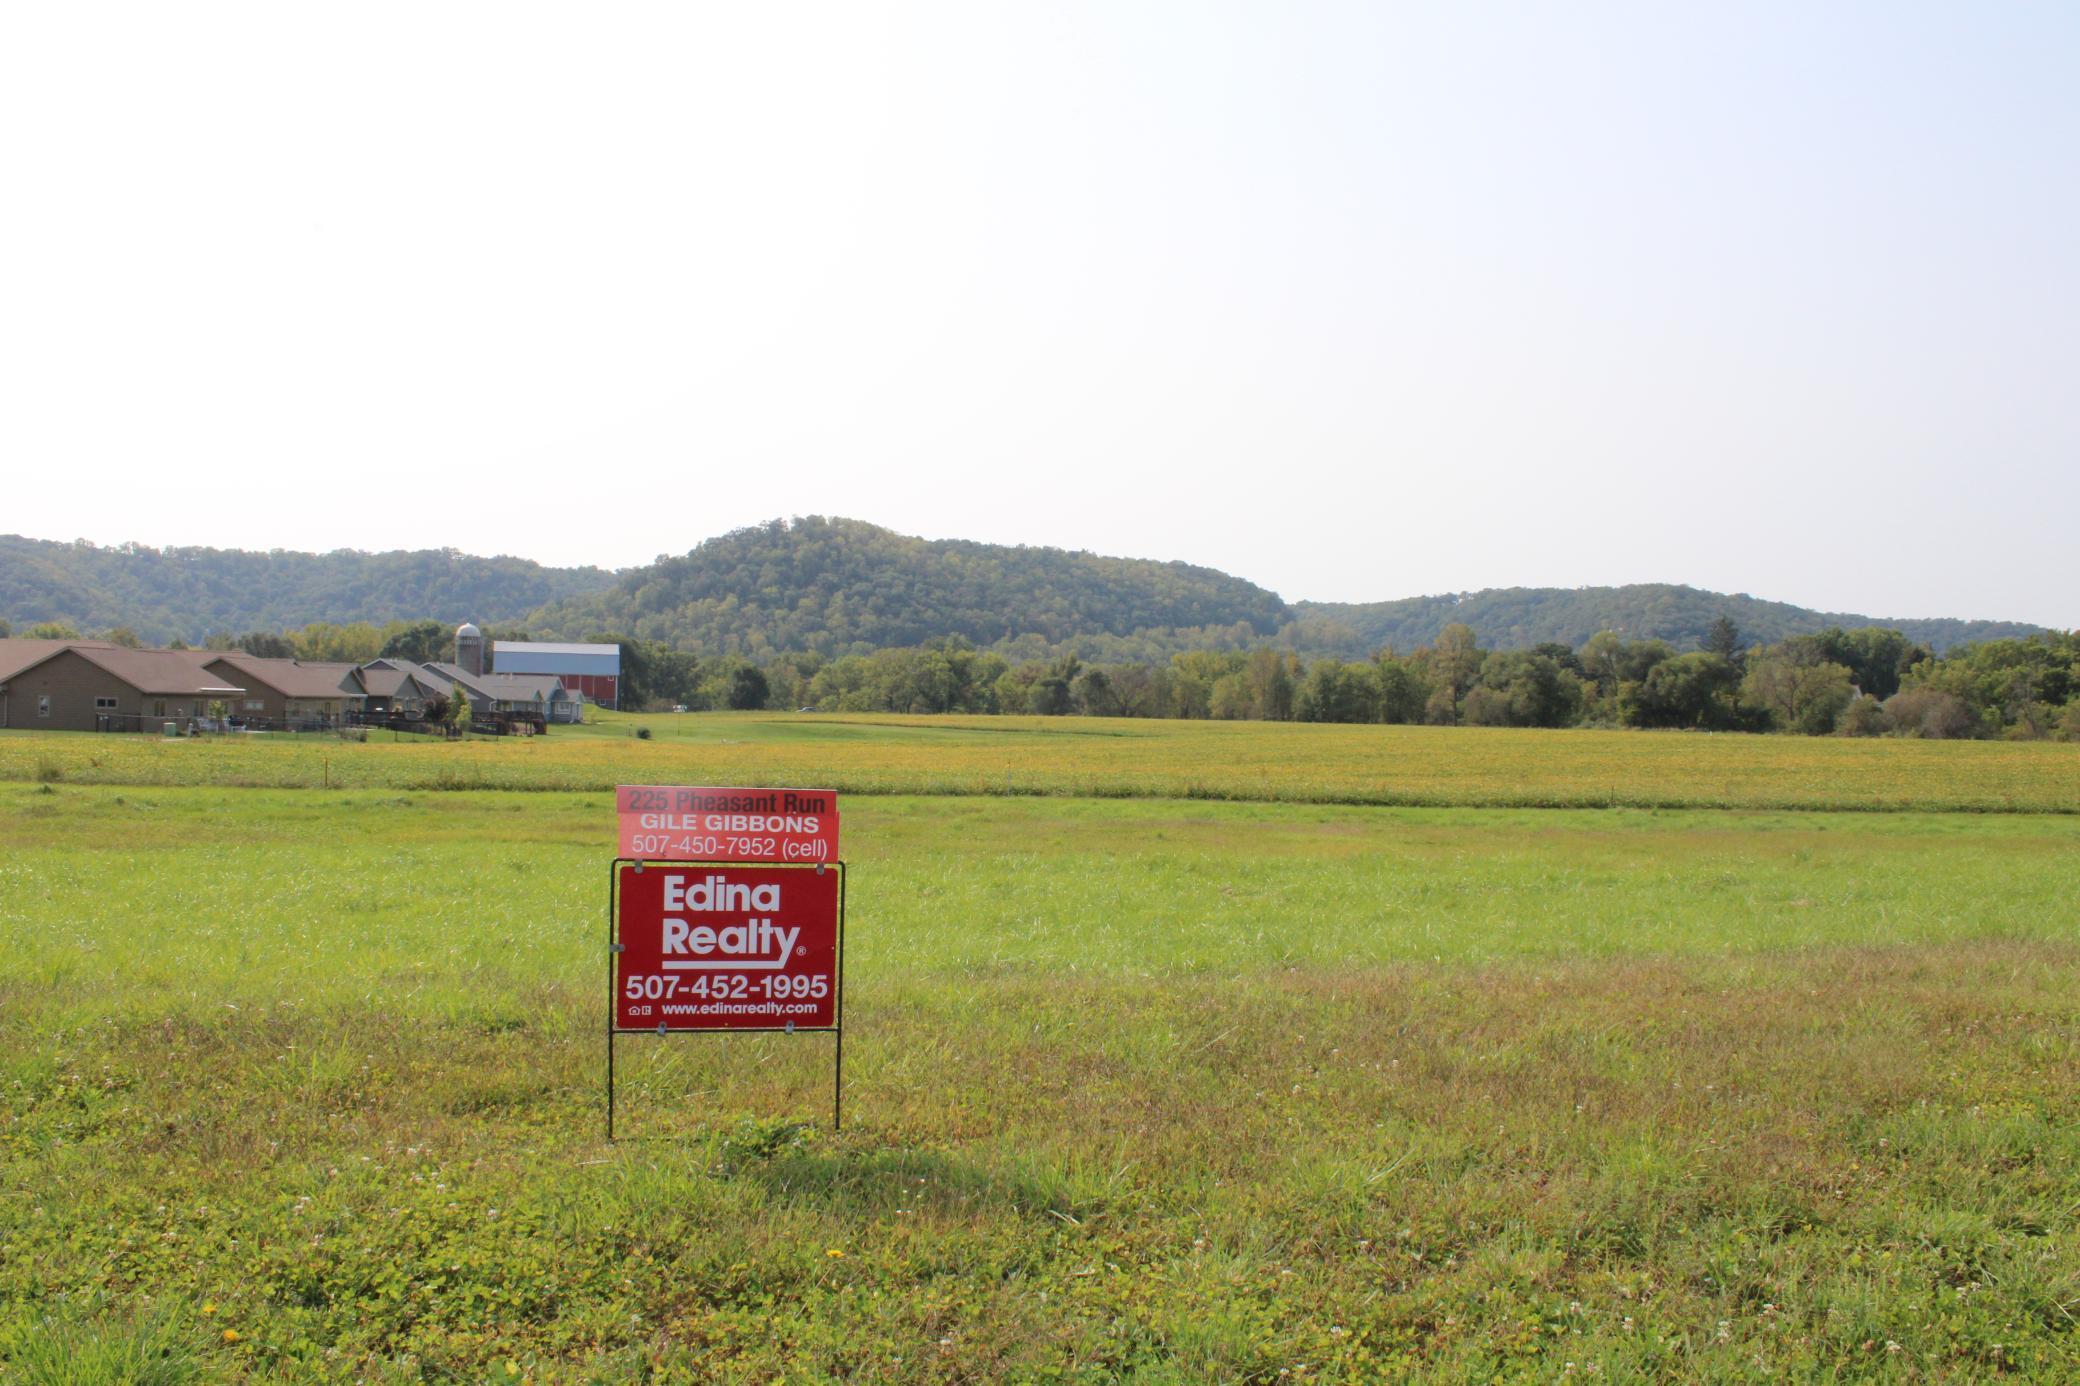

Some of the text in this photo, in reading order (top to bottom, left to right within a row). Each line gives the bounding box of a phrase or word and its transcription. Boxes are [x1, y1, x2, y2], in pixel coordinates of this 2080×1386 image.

[628, 790, 825, 813] 225 Pheasant Run
[640, 814, 819, 833] GILE GIBBONS
[632, 835, 828, 860] 507-450-7952 (cell)
[663, 875, 780, 911] Edina
[625, 975, 828, 999] 507-452-1995
[662, 1002, 818, 1016] www.edinarealty.com
